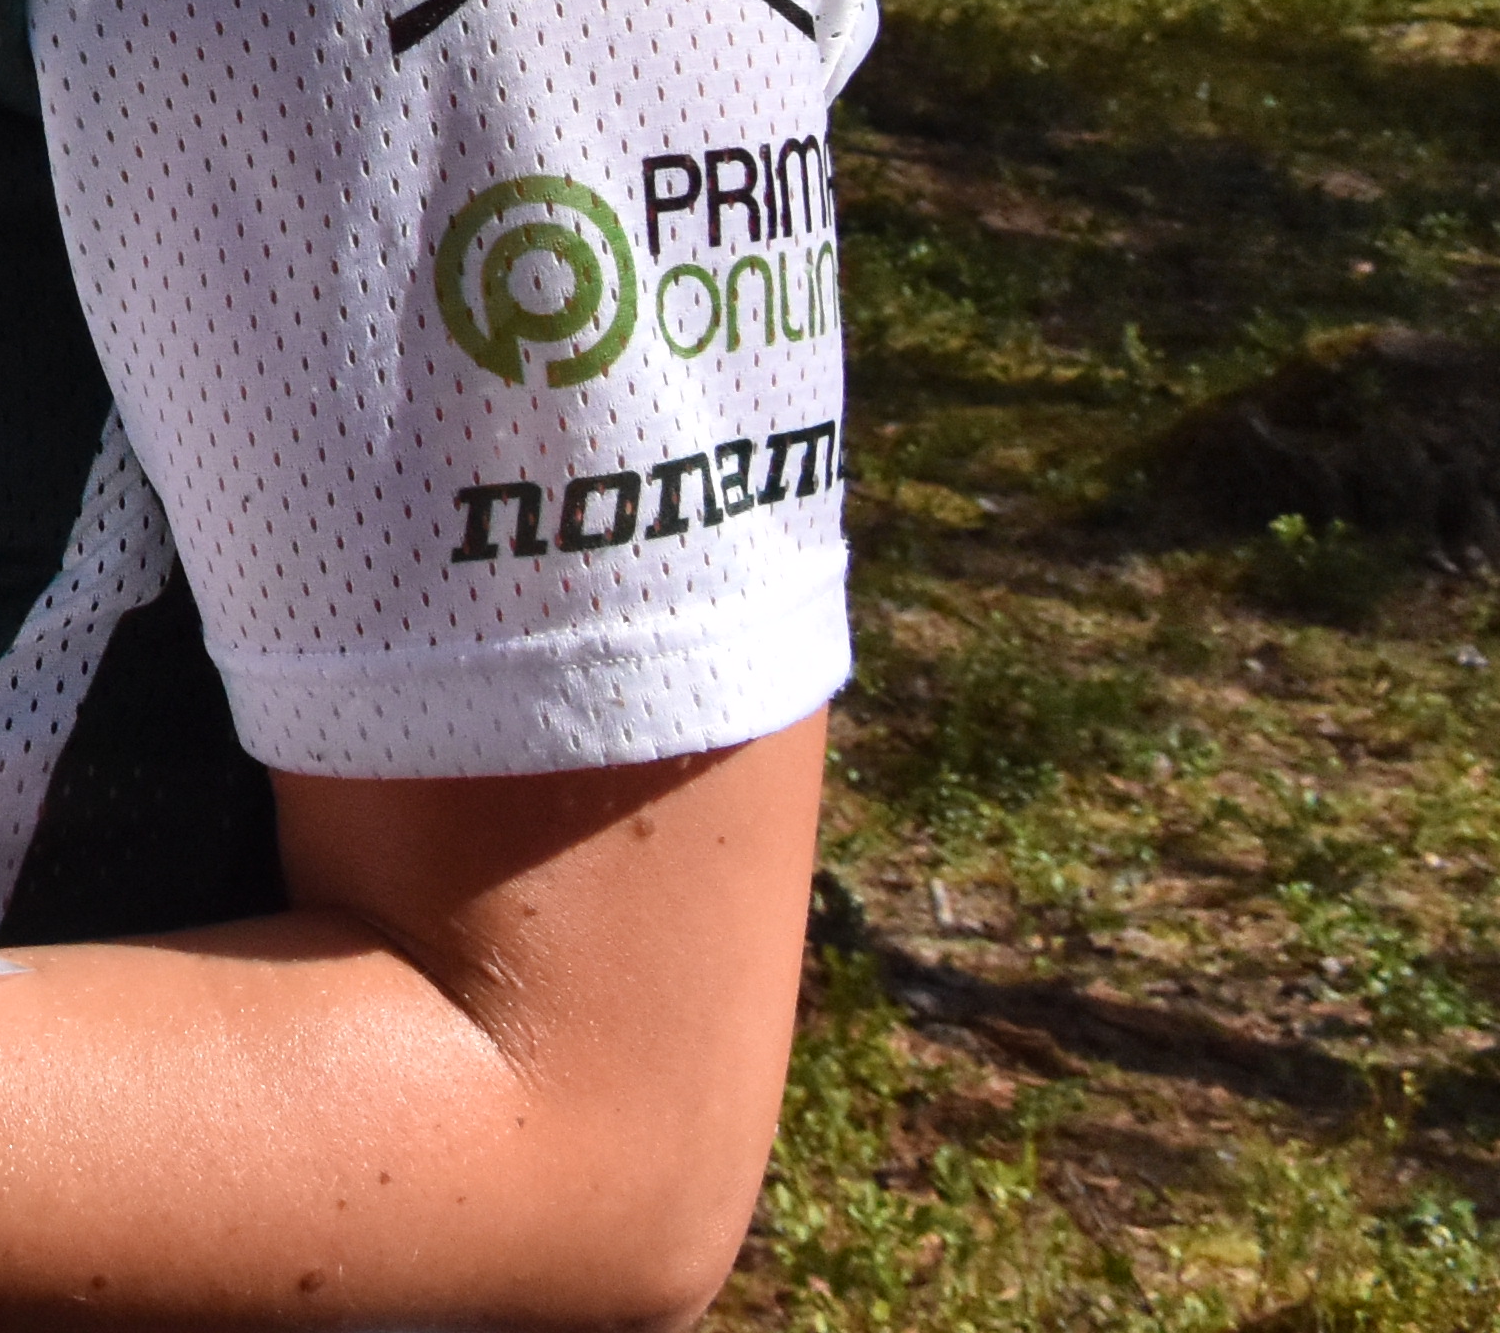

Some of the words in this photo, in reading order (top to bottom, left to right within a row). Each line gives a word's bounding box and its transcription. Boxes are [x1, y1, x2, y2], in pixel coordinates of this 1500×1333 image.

[642, 134, 837, 257] PRIM
[656, 240, 838, 359] ONLIN
[451, 421, 845, 564] nonam
